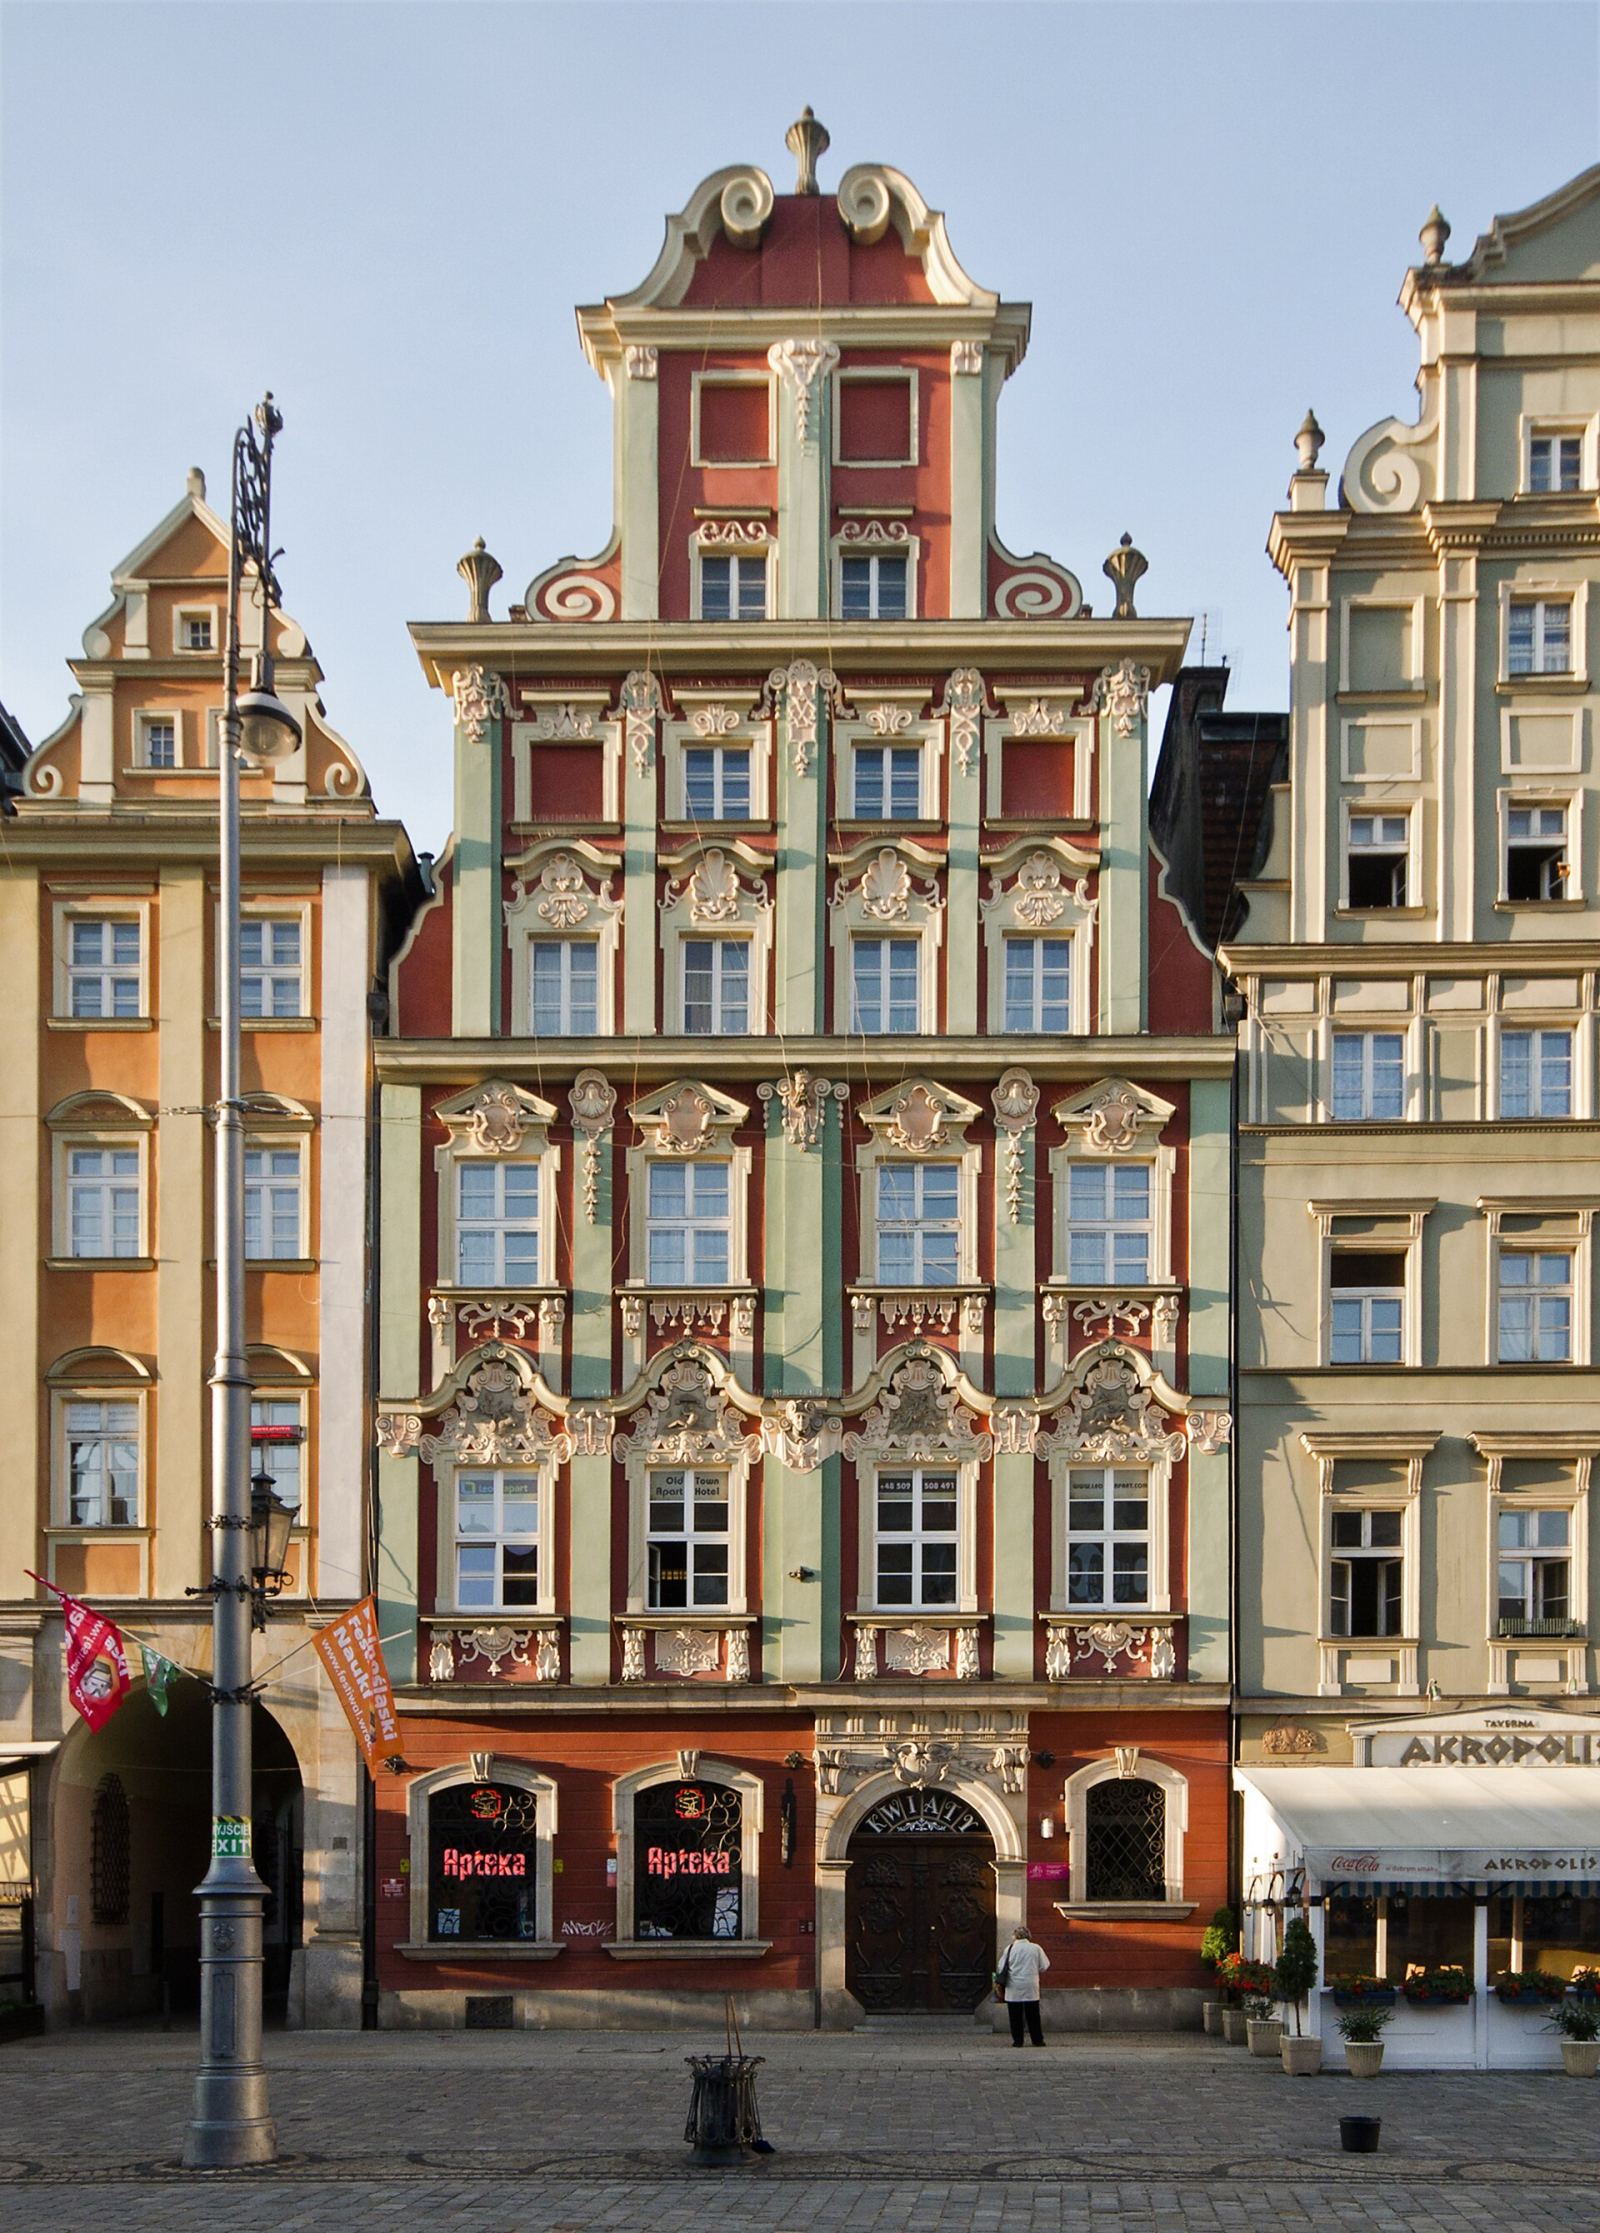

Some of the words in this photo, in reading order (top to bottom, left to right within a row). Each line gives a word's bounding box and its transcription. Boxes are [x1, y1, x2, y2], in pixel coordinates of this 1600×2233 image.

[656, 1487, 684, 1498] Apart
[695, 1487, 719, 1496] Hotel
[666, 1476, 684, 1485] Old
[695, 1477, 719, 1485] Town
[333, 1625, 373, 1699] Nauki
[1485, 1719, 1535, 1728] TAVERNA
[1401, 1734, 1600, 1765] AKROPOLI
[865, 1795, 979, 1833] KWIATY
[444, 1848, 526, 1881] Apteka
[648, 1847, 730, 1879] Apteka
[1484, 1857, 1597, 1870] AKROPOLIS
